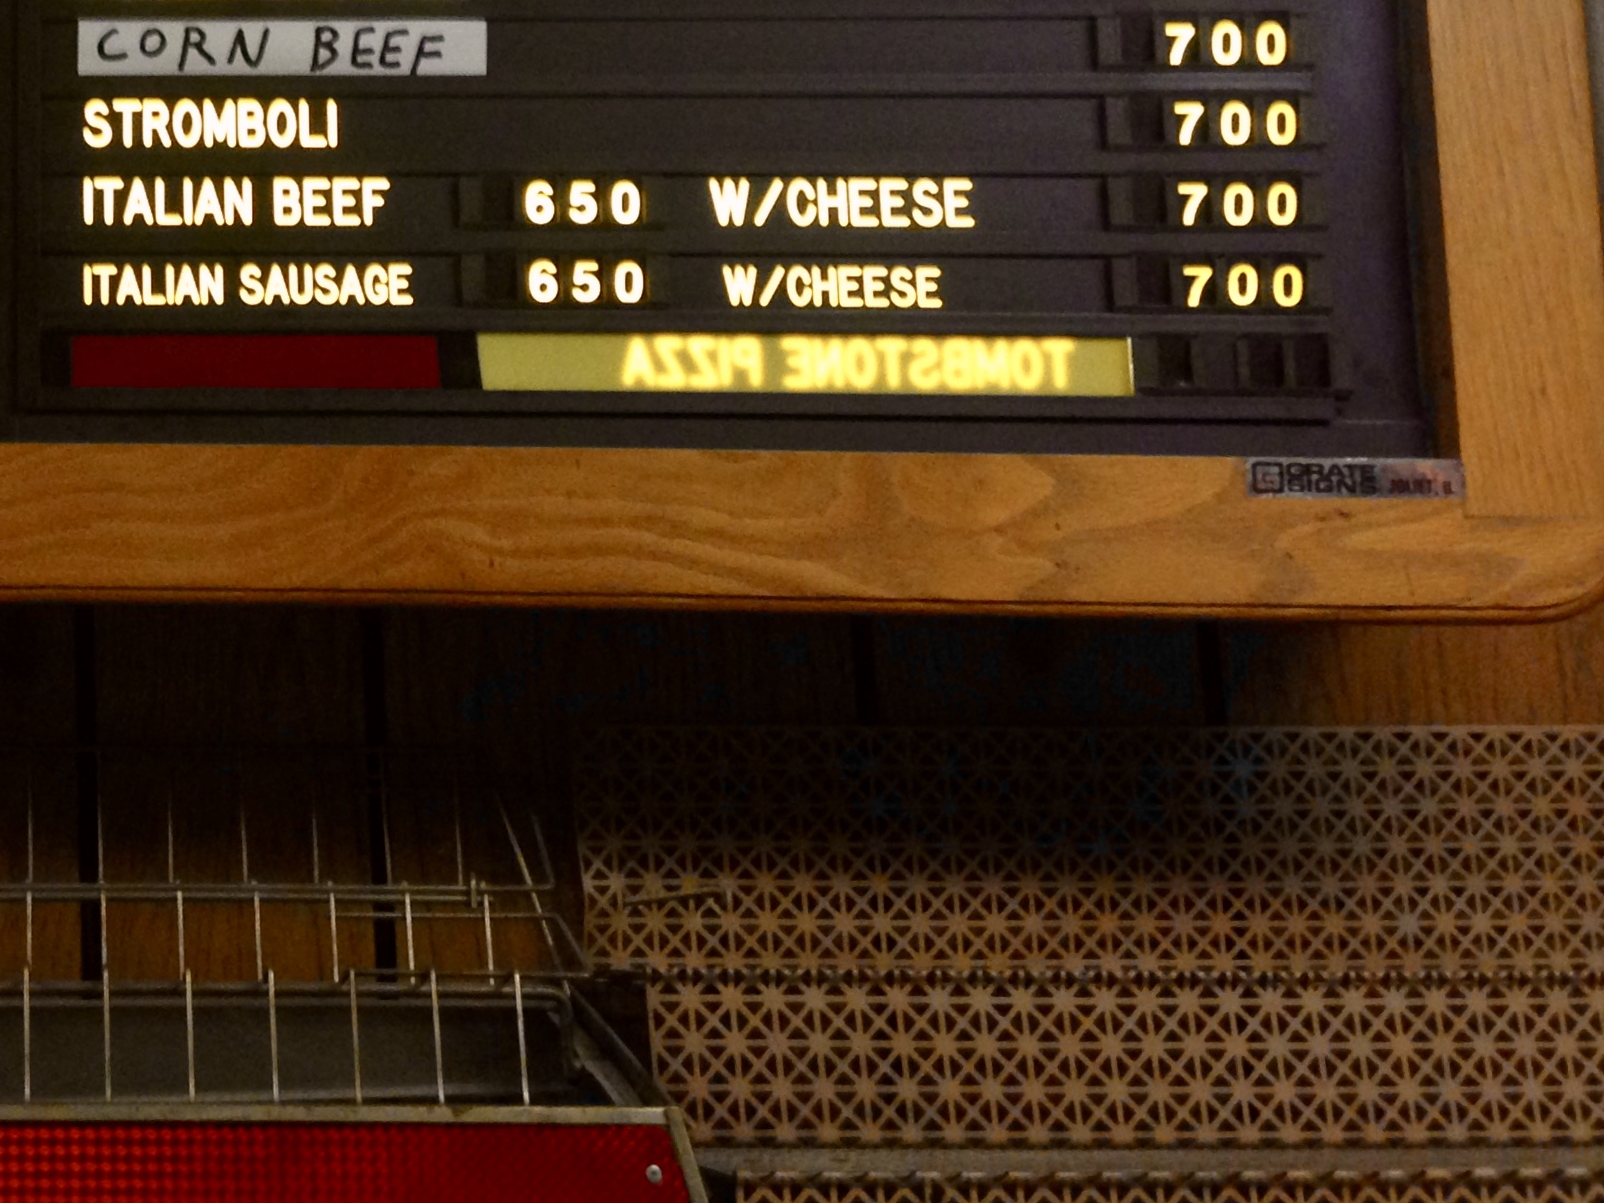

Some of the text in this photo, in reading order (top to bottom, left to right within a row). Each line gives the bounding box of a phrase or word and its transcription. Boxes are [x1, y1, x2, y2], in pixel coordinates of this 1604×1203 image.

[96, 25, 445, 75] CORN BEEF
[1165, 19, 1288, 66] 700
[82, 98, 1296, 148] STROMBOLI 700
[82, 176, 1298, 228] ITALIAN BEEF 650 W/CHEESE 700
[82, 259, 1303, 309] ITALIAN SAUSAGE 650 W/CHEESE 700
